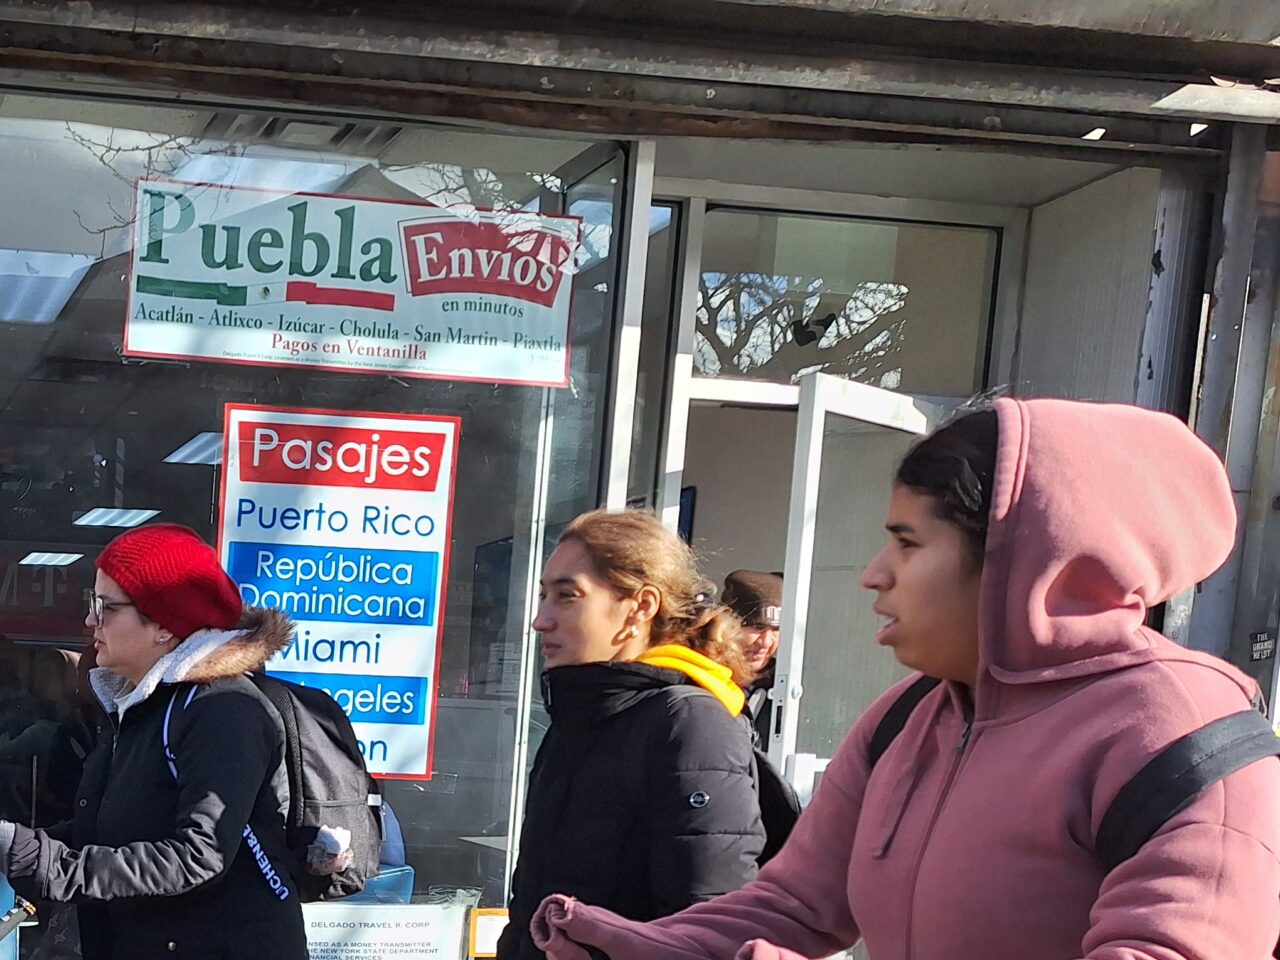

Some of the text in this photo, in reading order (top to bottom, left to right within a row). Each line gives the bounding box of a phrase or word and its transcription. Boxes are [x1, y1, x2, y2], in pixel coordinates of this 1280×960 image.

[139, 189, 398, 284] Puebla
[442, 298, 524, 318] en minutos
[134, 302, 194, 324] Acatlán
[208, 308, 263, 329] Atlixco
[278, 313, 326, 334] Izúcar
[339, 319, 399, 340] Cholula
[413, 324, 442, 344] San
[513, 332, 561, 353] Piaxtla
[271, 333, 427, 361] Pagos en Ventanilla
[252, 427, 432, 484] Pasajes
[236, 498, 435, 537] Puerto Rico
[256, 550, 414, 587] República
[238, 583, 425, 619] Dominicana
[311, 921, 356, 929] DELGADO
